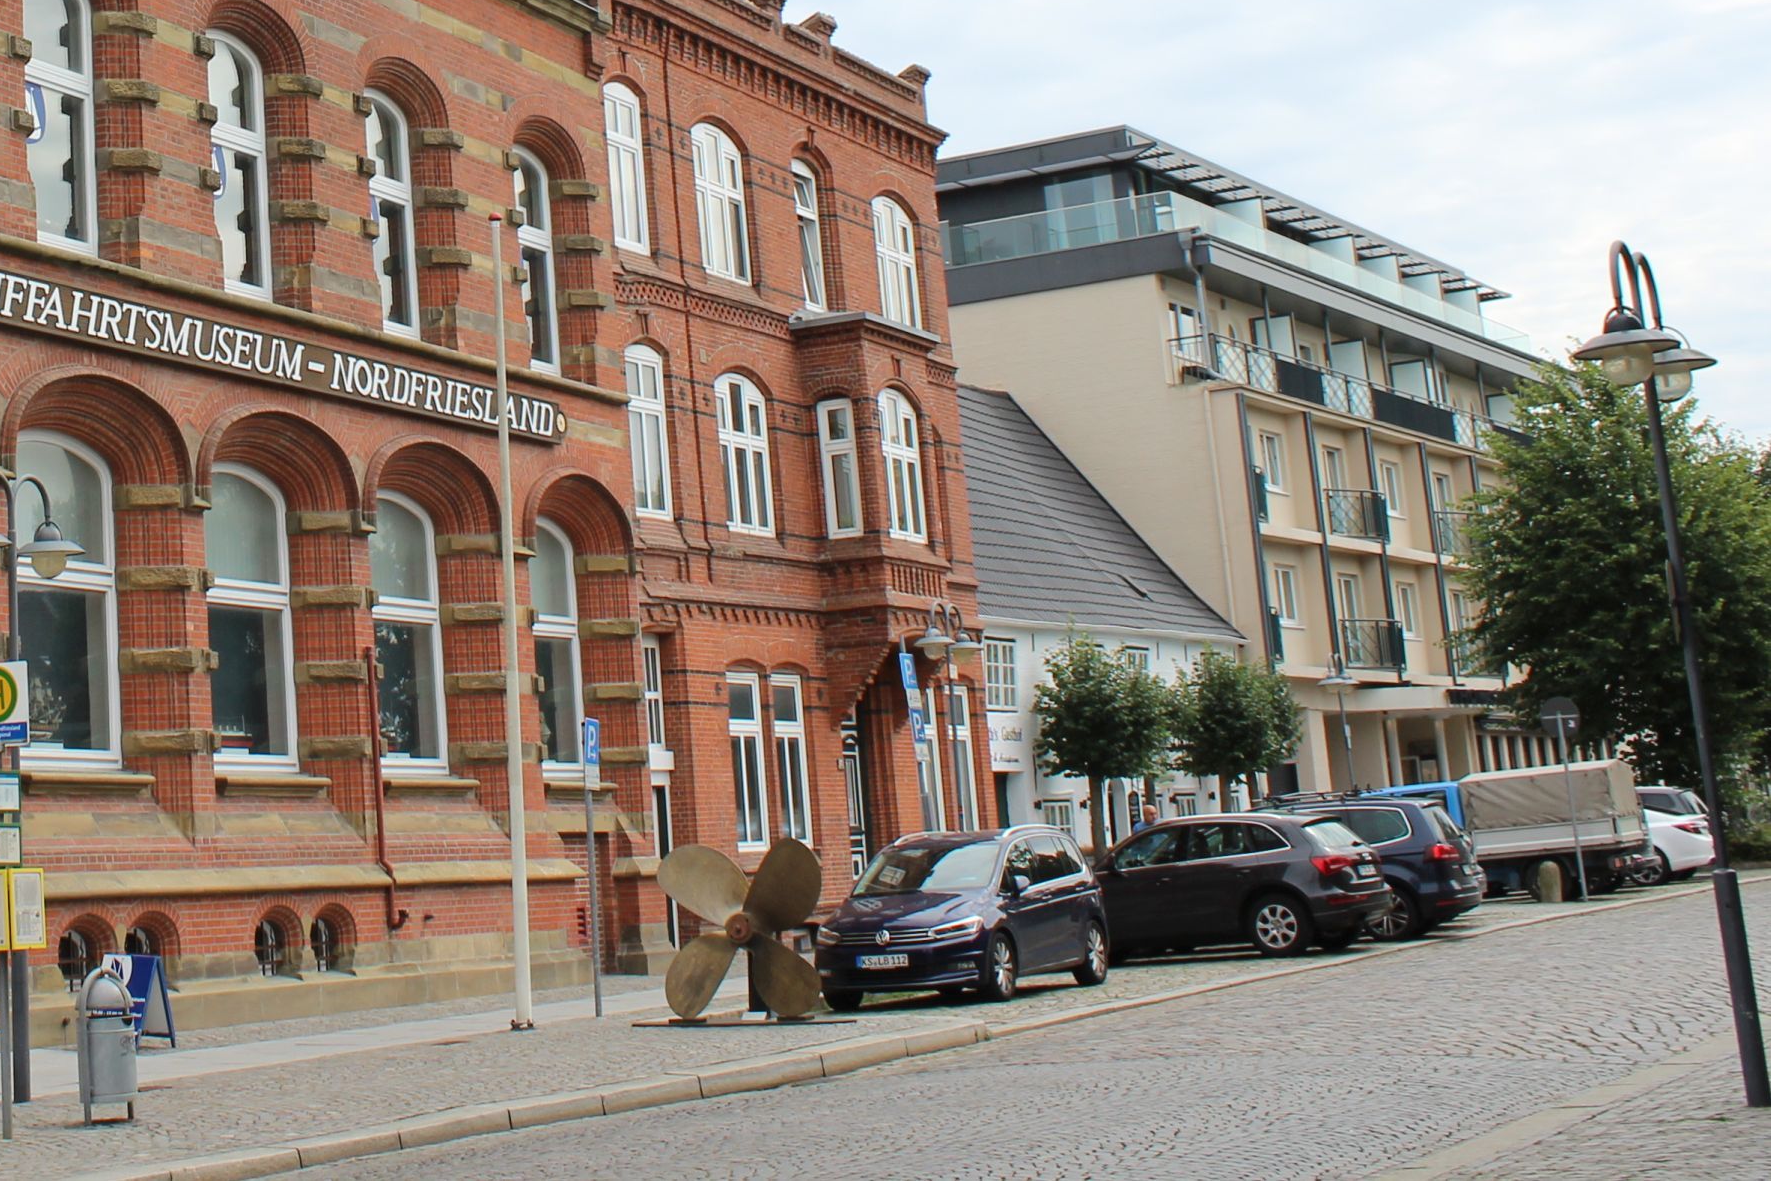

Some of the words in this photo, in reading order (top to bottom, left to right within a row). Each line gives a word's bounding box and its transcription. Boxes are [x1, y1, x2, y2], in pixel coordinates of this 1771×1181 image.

[330, 352, 555, 437] NORDFRIESLAND
[588, 725, 597, 759] P
[891, 954, 908, 966] 112
